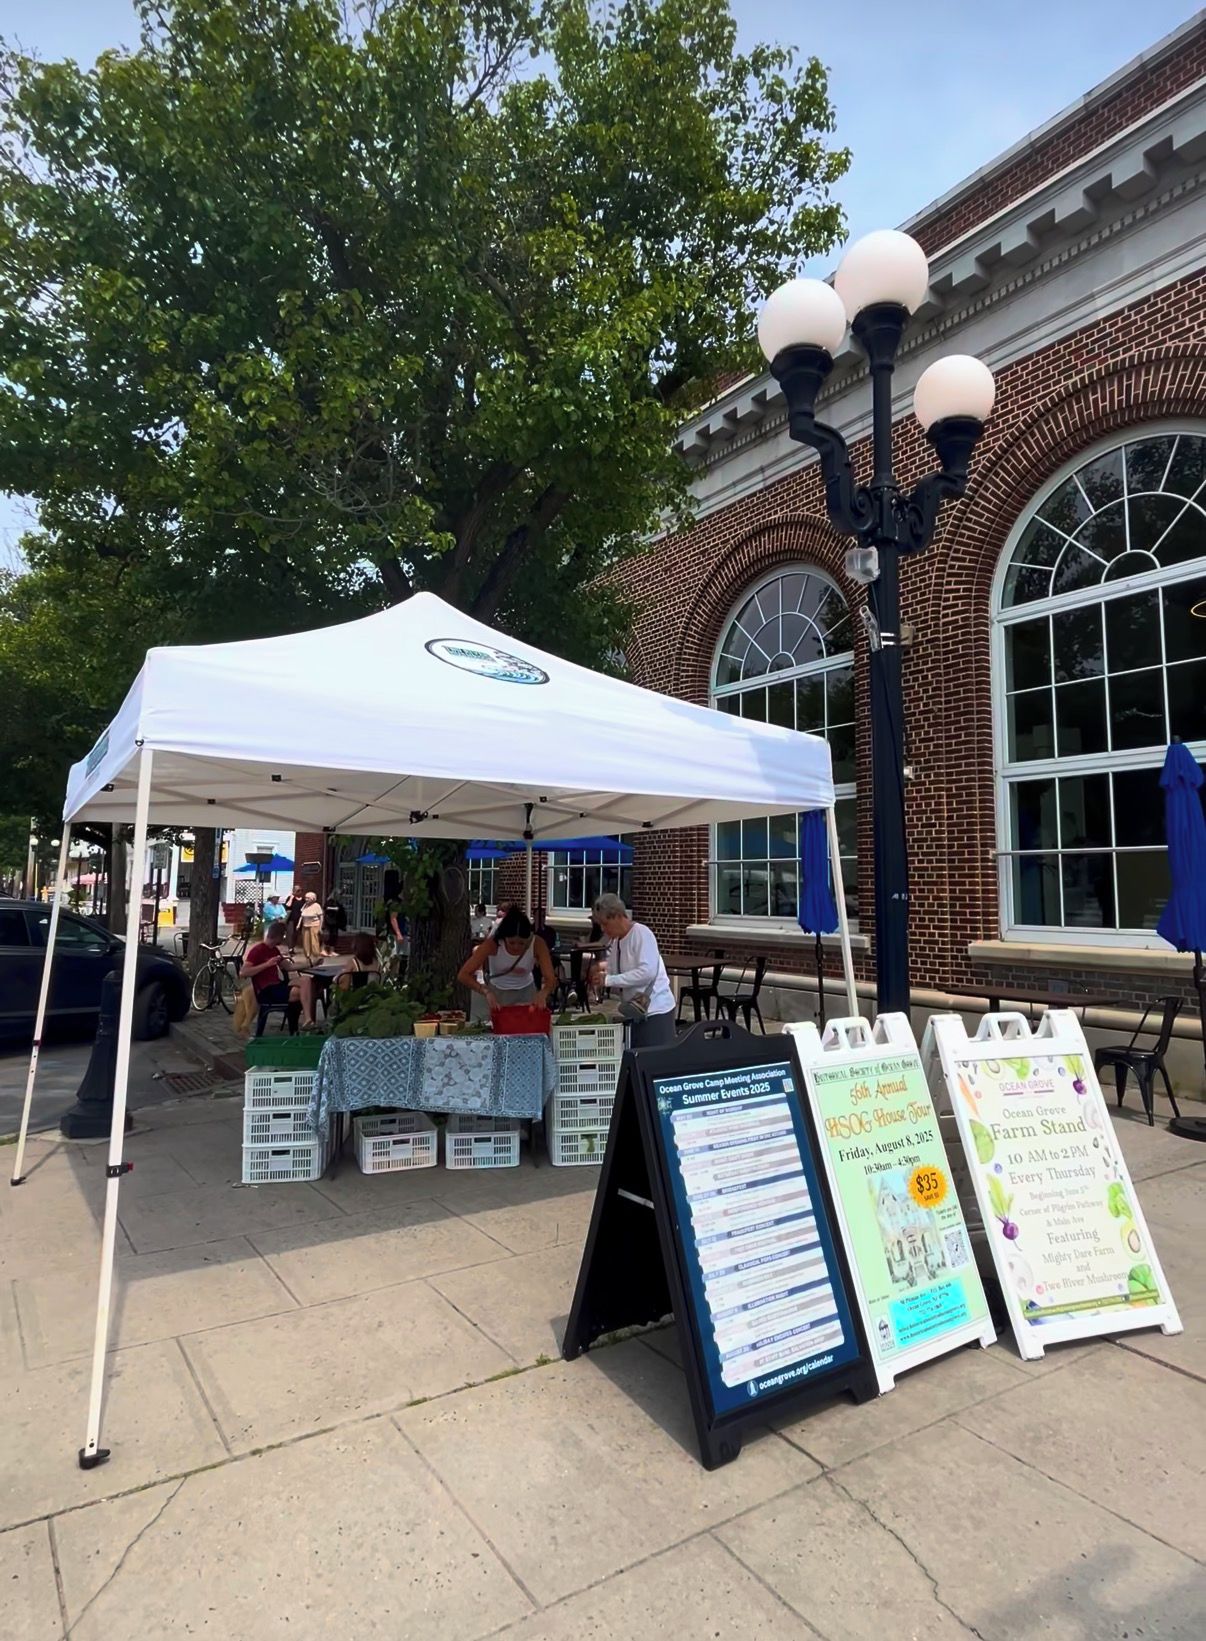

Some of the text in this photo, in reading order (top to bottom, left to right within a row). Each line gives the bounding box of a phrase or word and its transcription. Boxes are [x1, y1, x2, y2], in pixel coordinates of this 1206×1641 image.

[660, 1069, 786, 1094] Ocean Grove Camp Meeting Association
[850, 1075, 908, 1106] 56th Annual
[999, 1079, 1055, 1092] OCEAN GROVE
[682, 1082, 770, 1105] Summer Events 2025
[824, 1101, 931, 1140] HSOG House Tour
[1002, 1105, 1066, 1120] Ocean Grove
[990, 1116, 1088, 1141] Farm Stand
[838, 1130, 934, 1162] Friday, August 8, 2025
[1008, 1145, 1089, 1165] 10 AM to 2 PM
[916, 1172, 938, 1195] $35
[1008, 1165, 1096, 1185] Every Thursday
[1046, 1229, 1100, 1245] Featuring
[1042, 1251, 1072, 1266] Mighty
[1093, 1246, 1115, 1256] Farm
[1076, 1262, 1091, 1272] and
[1062, 1278, 1084, 1288] River
[760, 1354, 834, 1390] oceangrove.org/calendar
